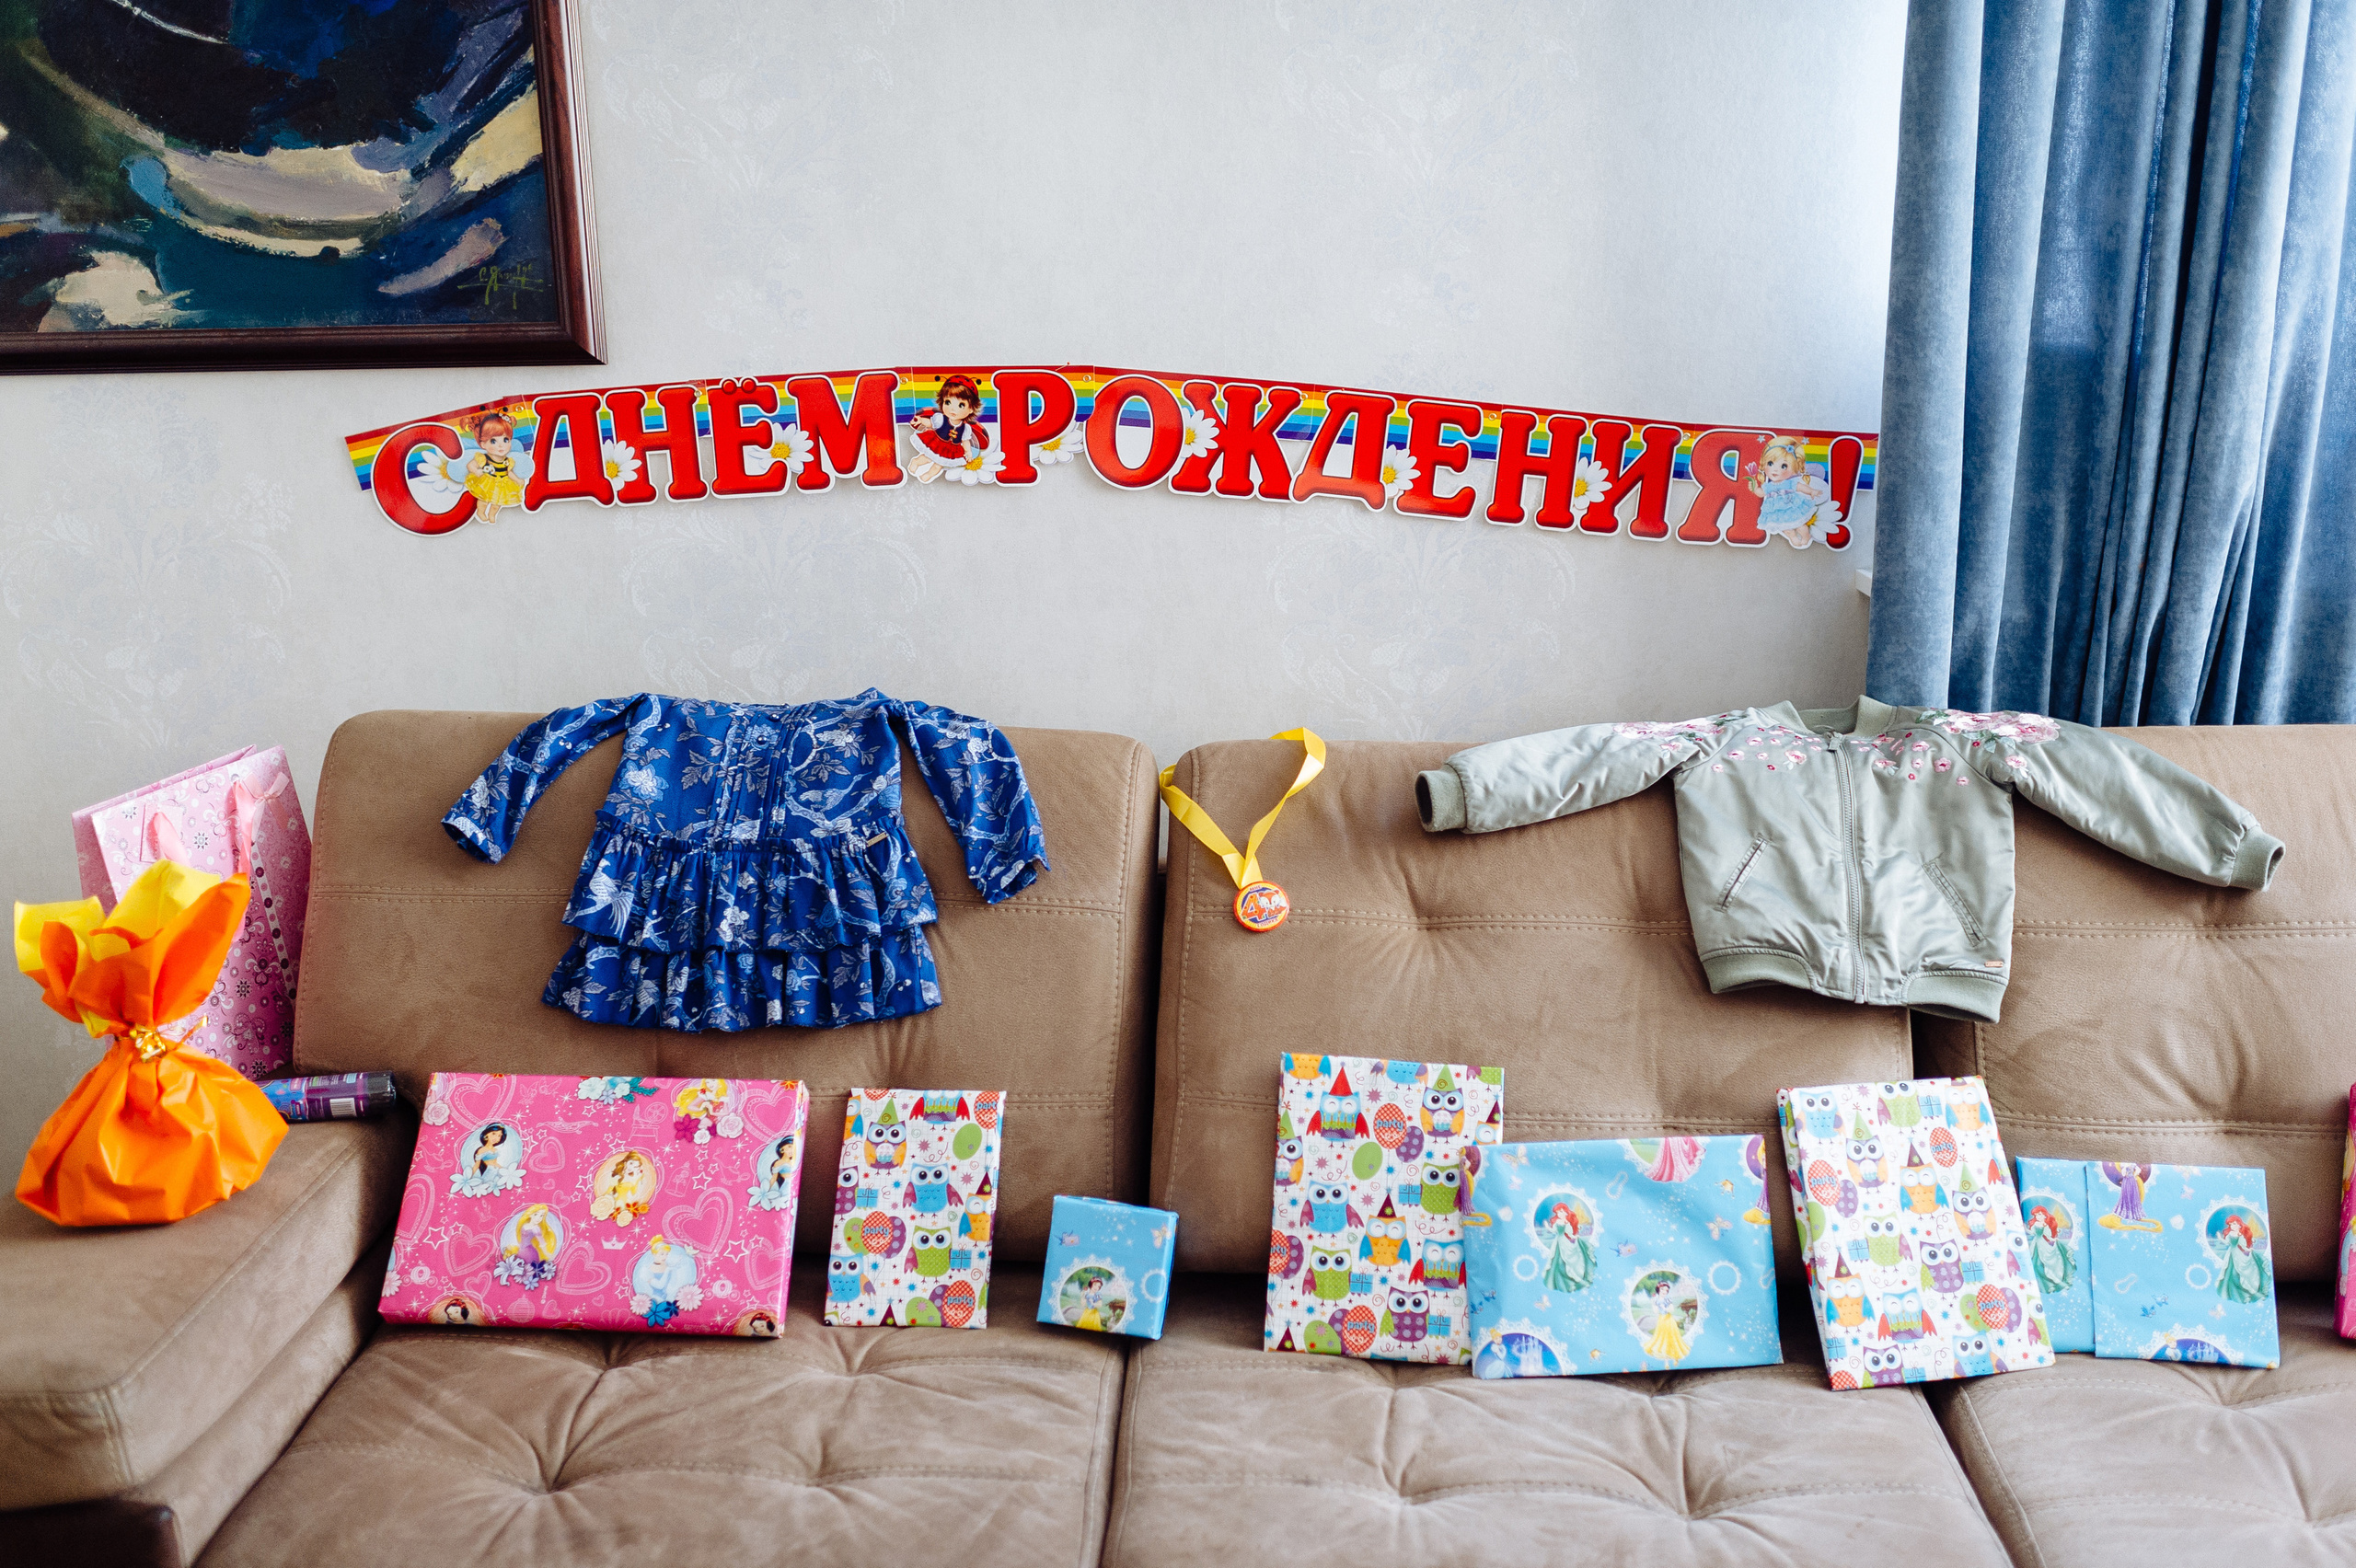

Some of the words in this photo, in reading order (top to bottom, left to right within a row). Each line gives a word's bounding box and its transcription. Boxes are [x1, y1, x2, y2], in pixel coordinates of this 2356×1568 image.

[373, 423, 477, 535] С
[523, 371, 905, 512] ДНЁМ
[993, 371, 1864, 549] РОЖДЕНИЯ!
[1241, 893, 1267, 921] 4
[976, 1101, 997, 1111] part
[1376, 1117, 1403, 1132] party
[1931, 1142, 1954, 1154] party
[1810, 1175, 1837, 1187] party
[863, 1225, 890, 1237] party
[947, 1294, 974, 1308] party
[1980, 1298, 2004, 1312] party
[1347, 1320, 1375, 1333] party
